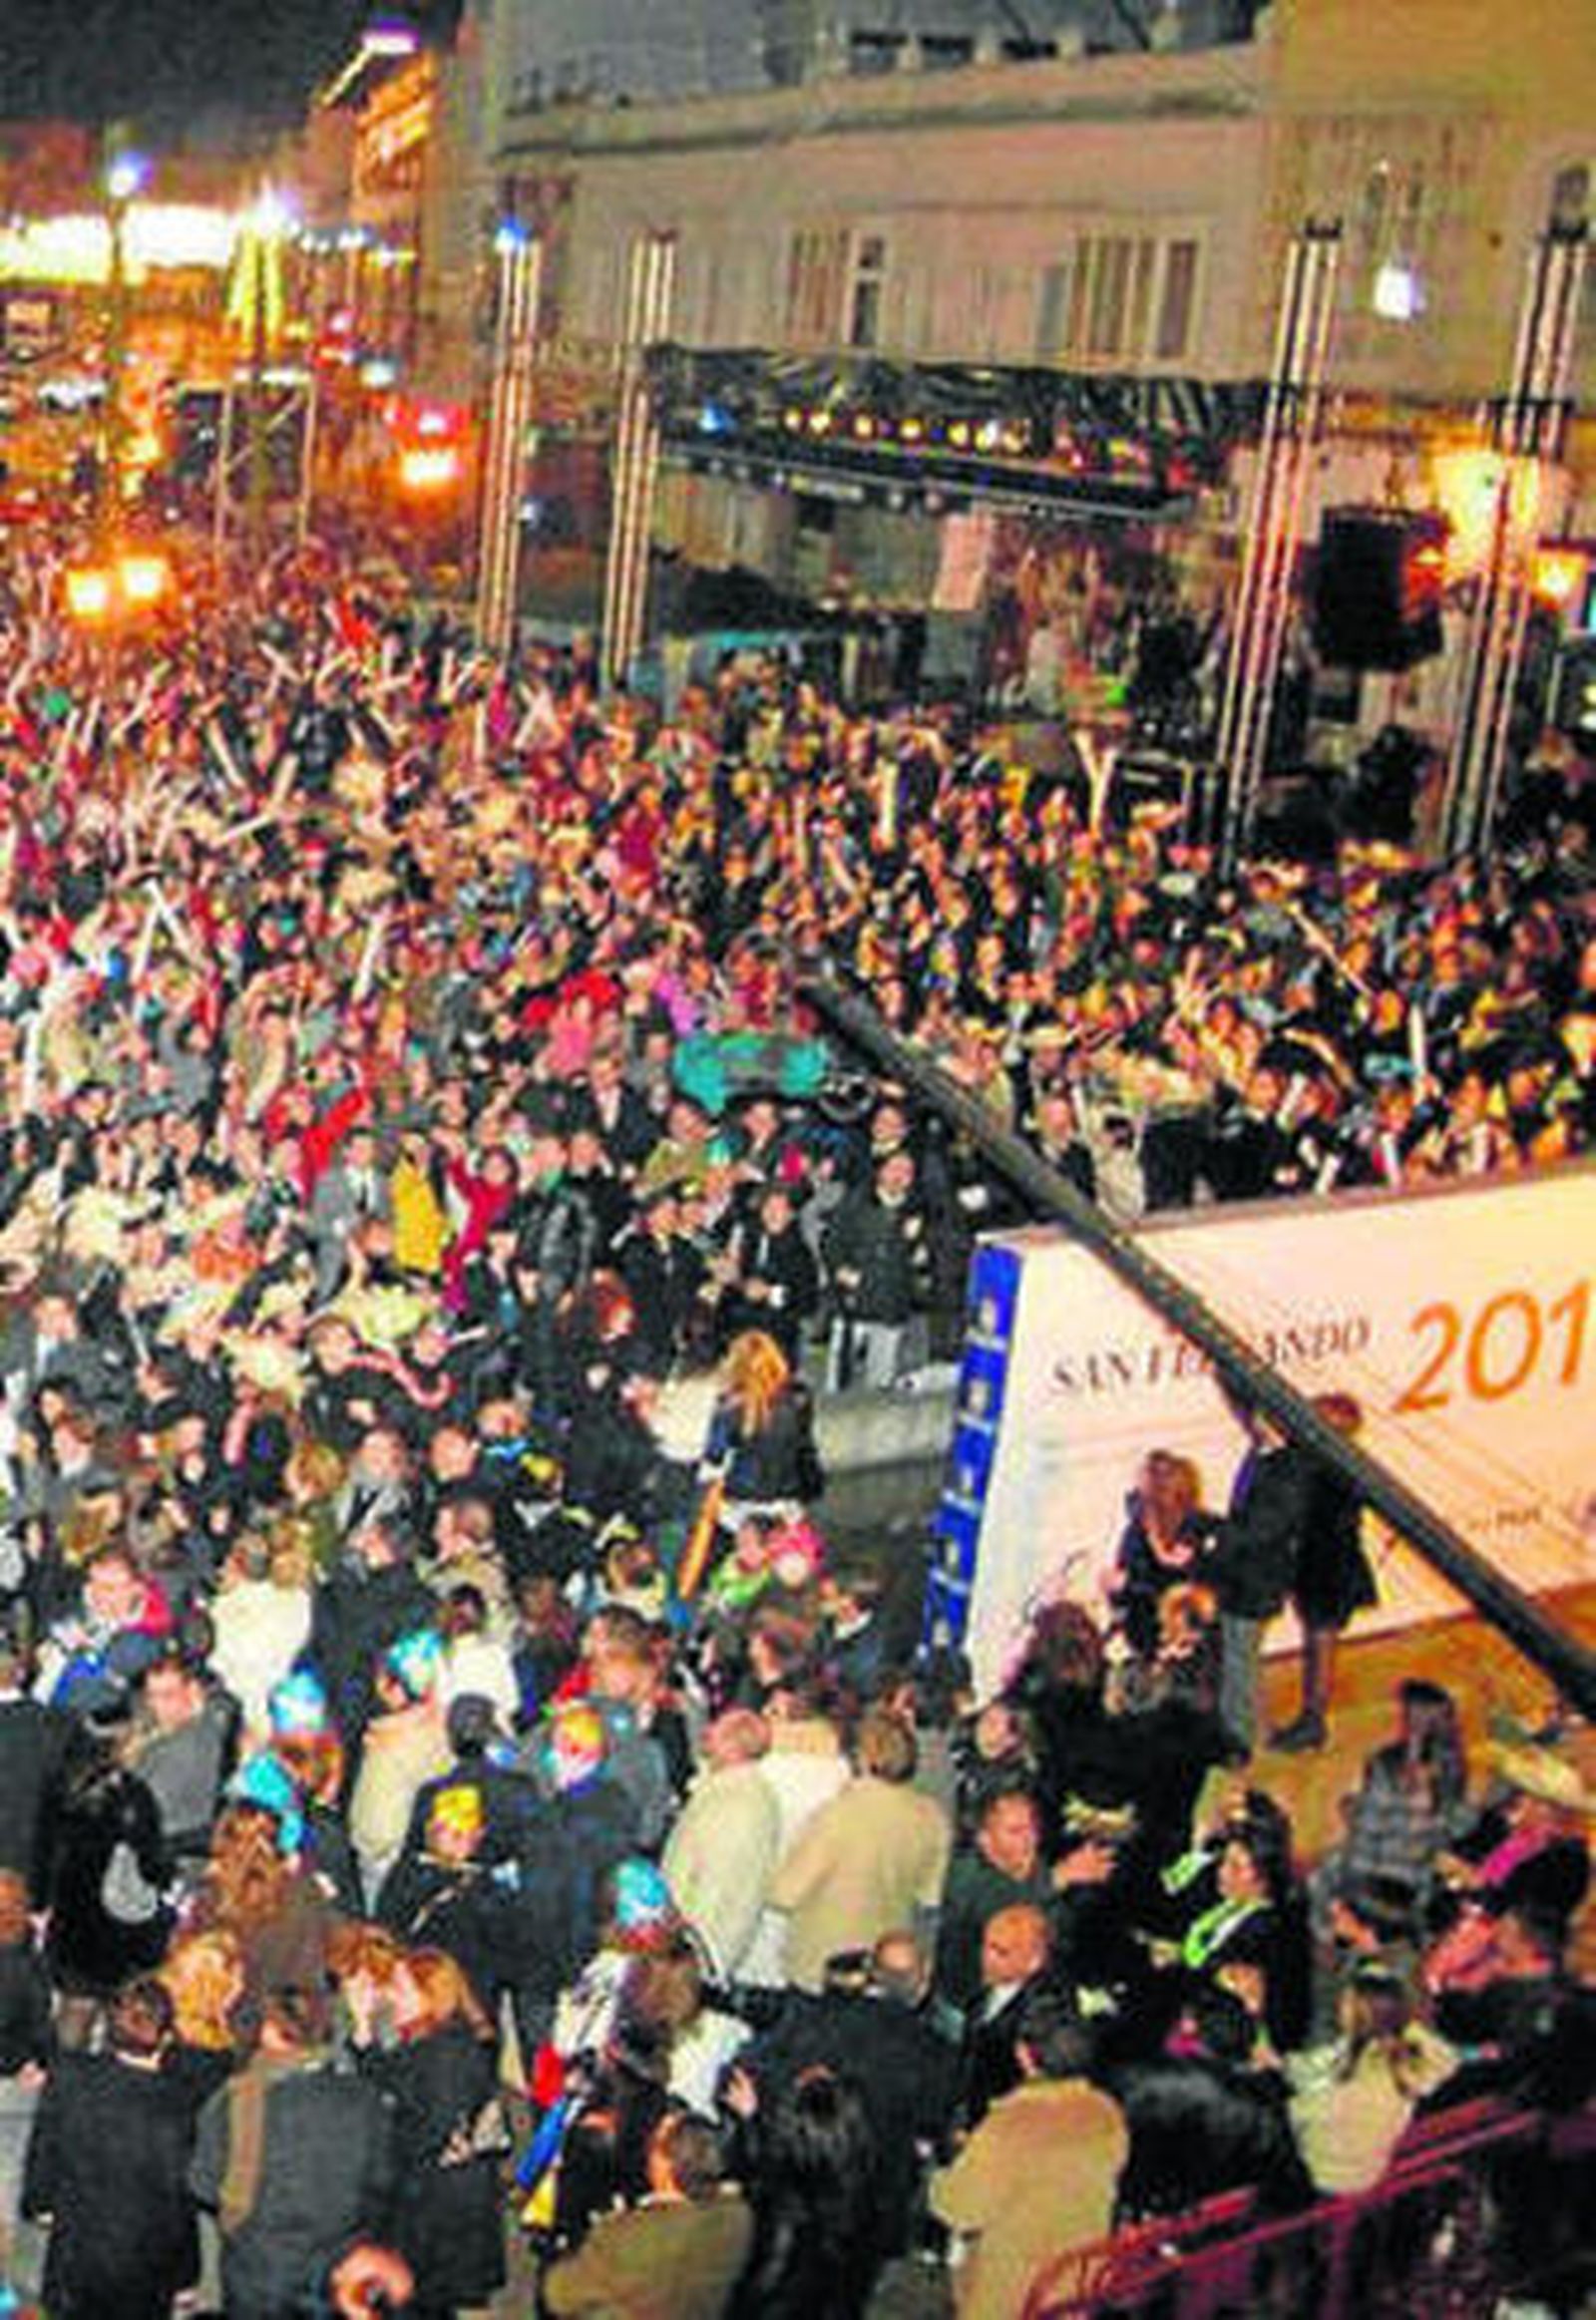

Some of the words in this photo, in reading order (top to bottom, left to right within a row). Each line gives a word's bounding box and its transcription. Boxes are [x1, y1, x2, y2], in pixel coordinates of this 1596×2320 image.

[1048, 1349, 1137, 1393] SAN
[1146, 1315, 1371, 1383] FEANDO
[1391, 1280, 1589, 1412] 201
